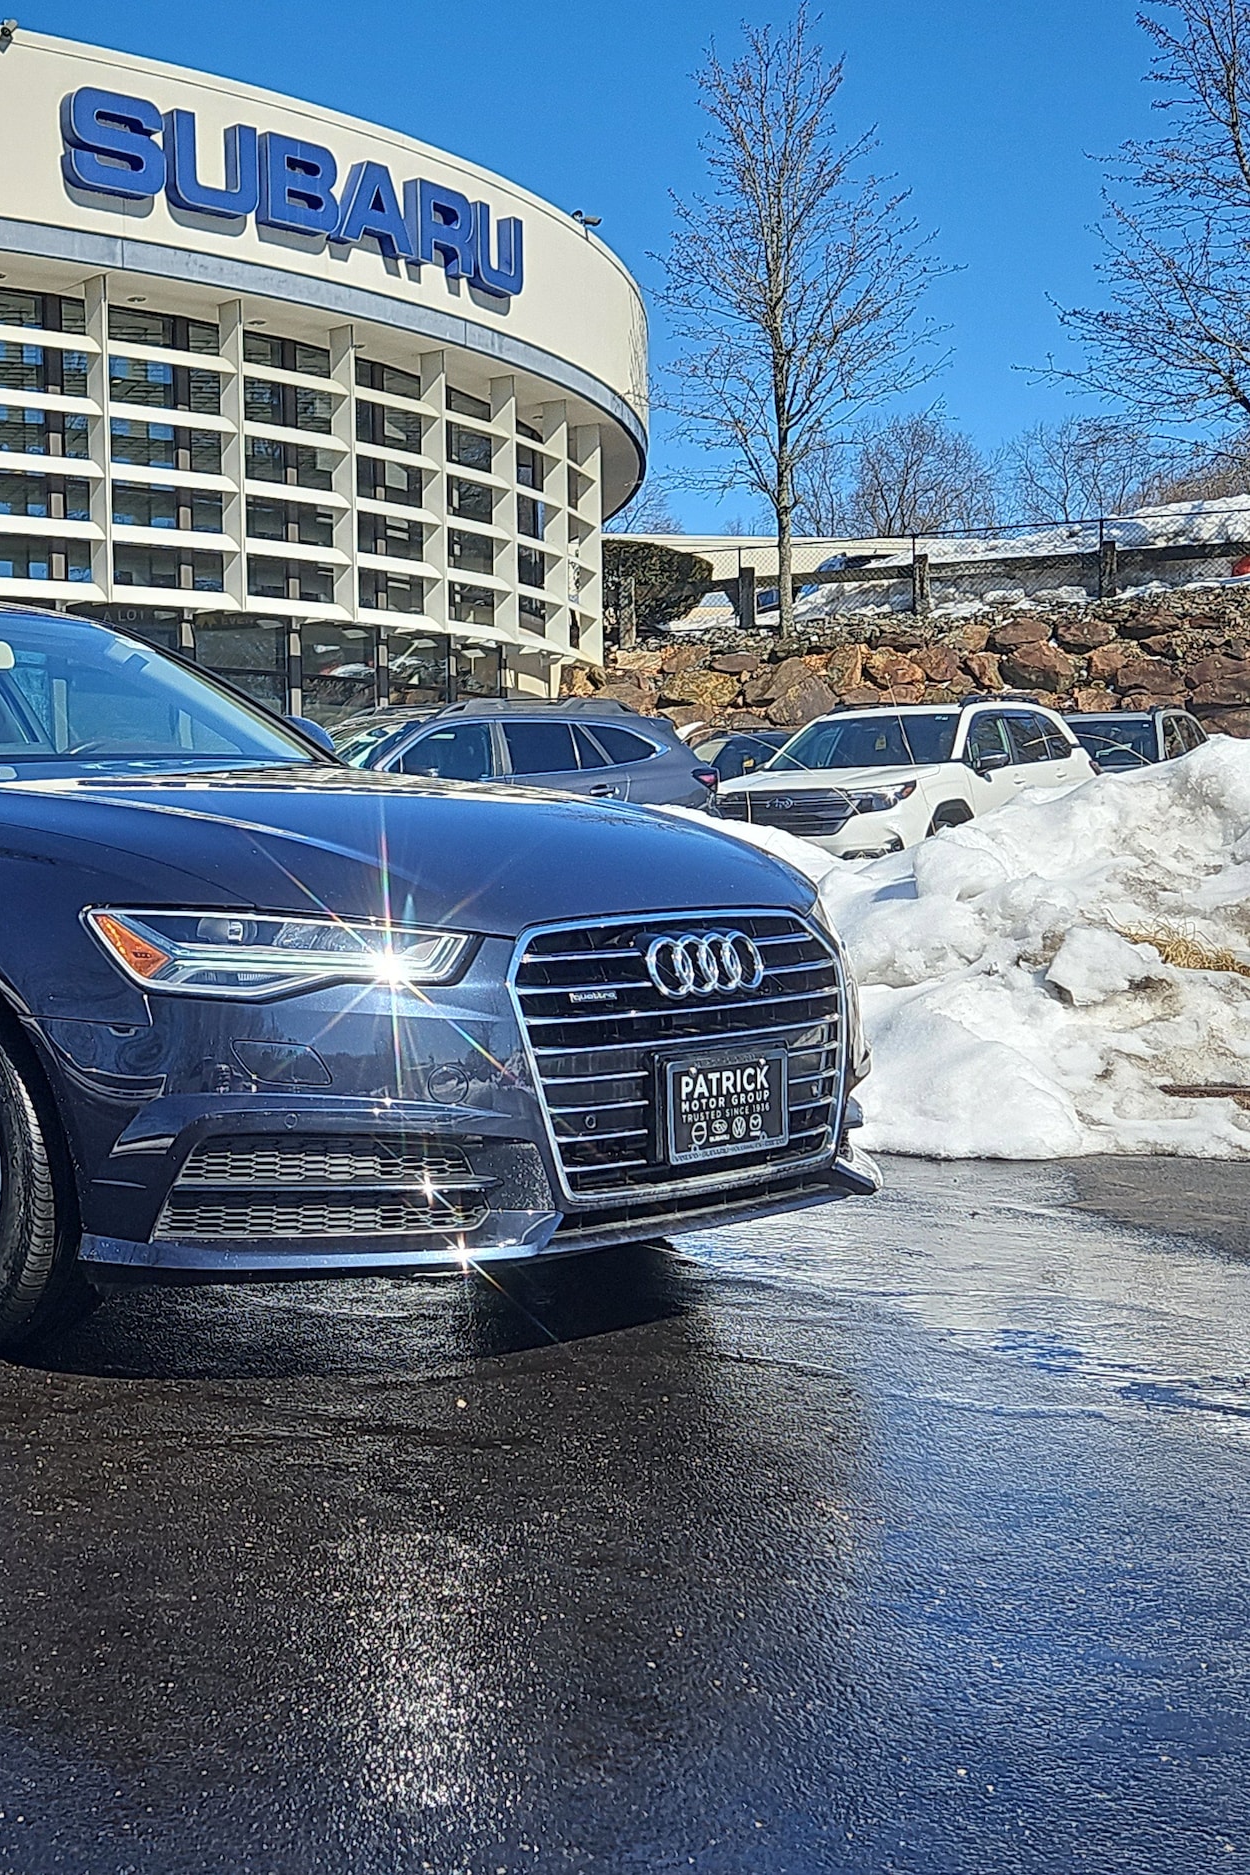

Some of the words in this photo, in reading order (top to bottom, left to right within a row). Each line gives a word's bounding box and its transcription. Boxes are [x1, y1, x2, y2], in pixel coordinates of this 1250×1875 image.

[61, 86, 524, 298] SUBARU
[572, 991, 617, 1002] quattro
[681, 1065, 769, 1100] PATRICK
[681, 1097, 725, 1113] MOTOR
[731, 1090, 770, 1105] GROUP
[682, 1110, 722, 1123] TRUSTED
[726, 1106, 749, 1118] SINCE
